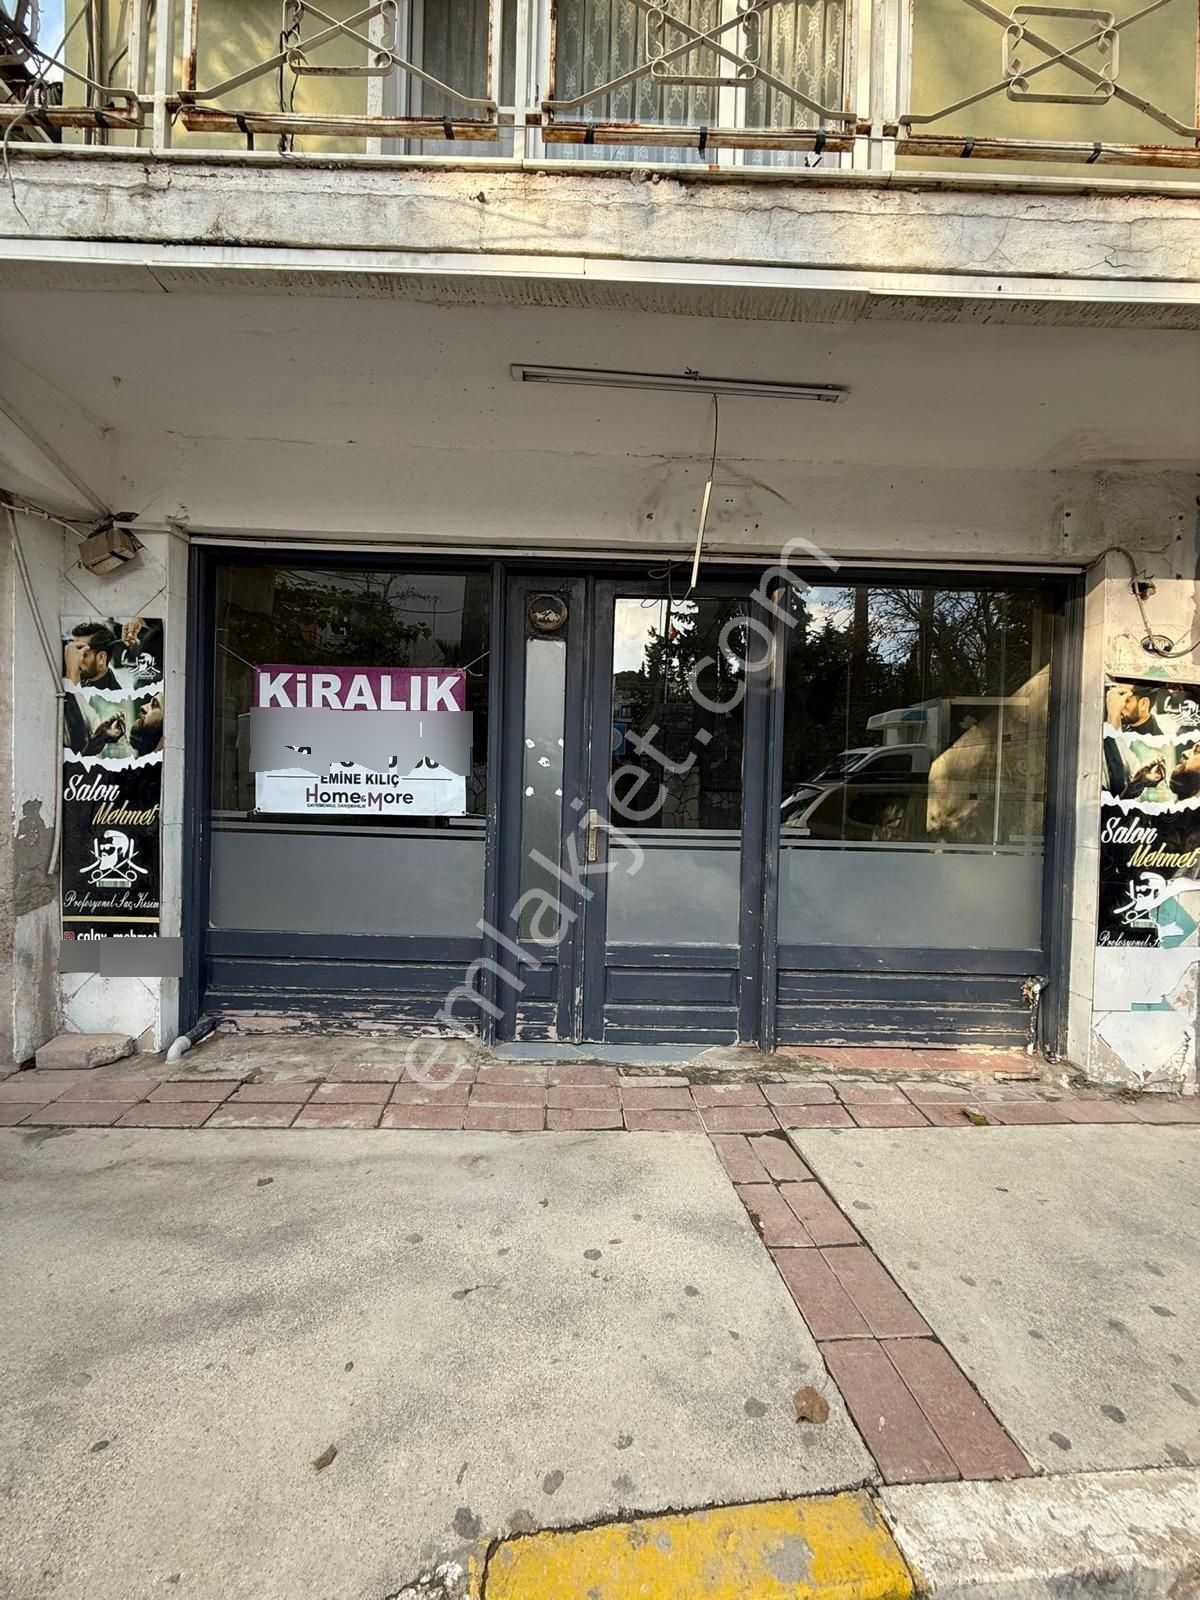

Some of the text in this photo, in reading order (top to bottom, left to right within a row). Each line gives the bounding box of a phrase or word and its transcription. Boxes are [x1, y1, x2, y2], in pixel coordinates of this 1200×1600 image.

[63, 773, 121, 802] Salon
[320, 771, 400, 788] EMİNE KILIÇ
[91, 799, 160, 826] Mehmet
[1100, 816, 1159, 845] Salon
[1126, 842, 1200, 869] Mehmet
